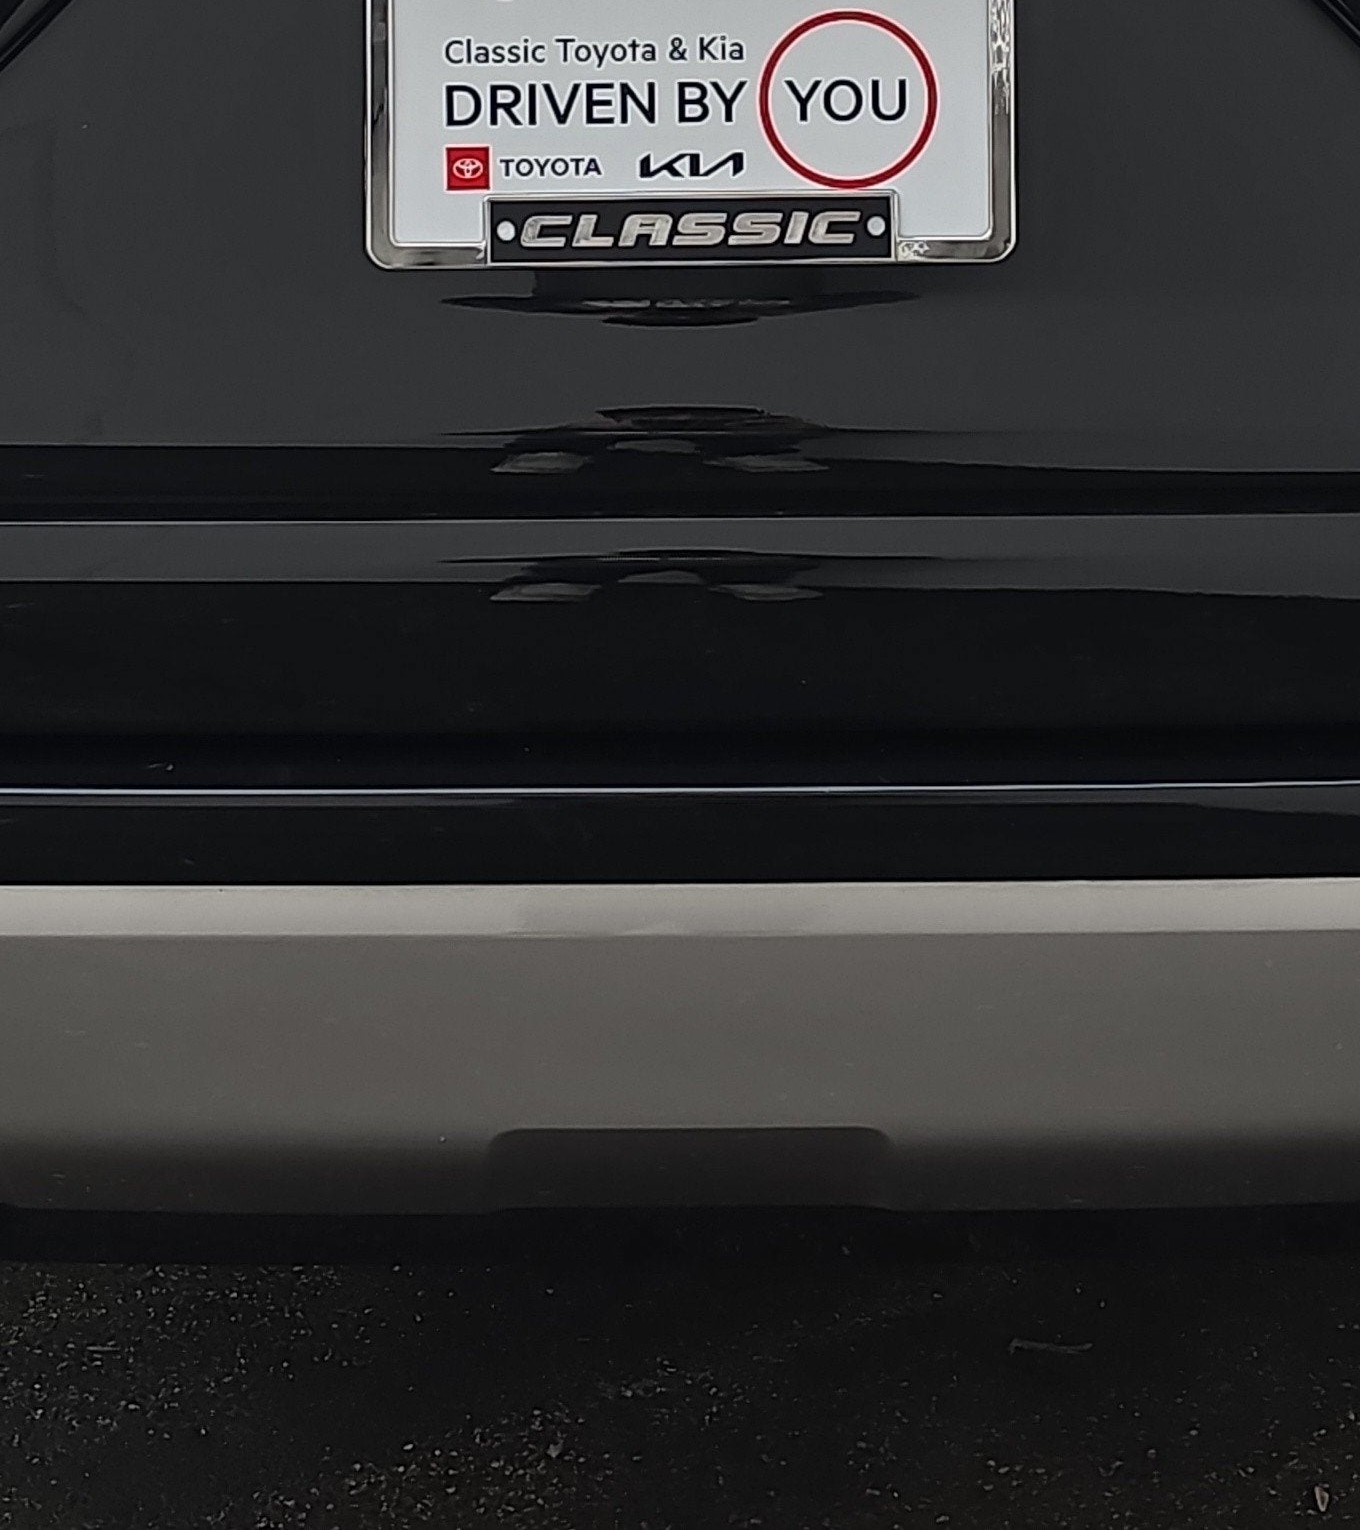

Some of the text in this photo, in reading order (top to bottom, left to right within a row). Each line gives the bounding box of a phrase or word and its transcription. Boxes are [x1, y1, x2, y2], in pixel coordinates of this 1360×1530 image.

[445, 35, 744, 68] Classic Toyota & Kia
[445, 78, 908, 127] DRIVEN BY YOU
[499, 158, 602, 178] TOYOTA
[519, 211, 861, 248] CLASSIC
